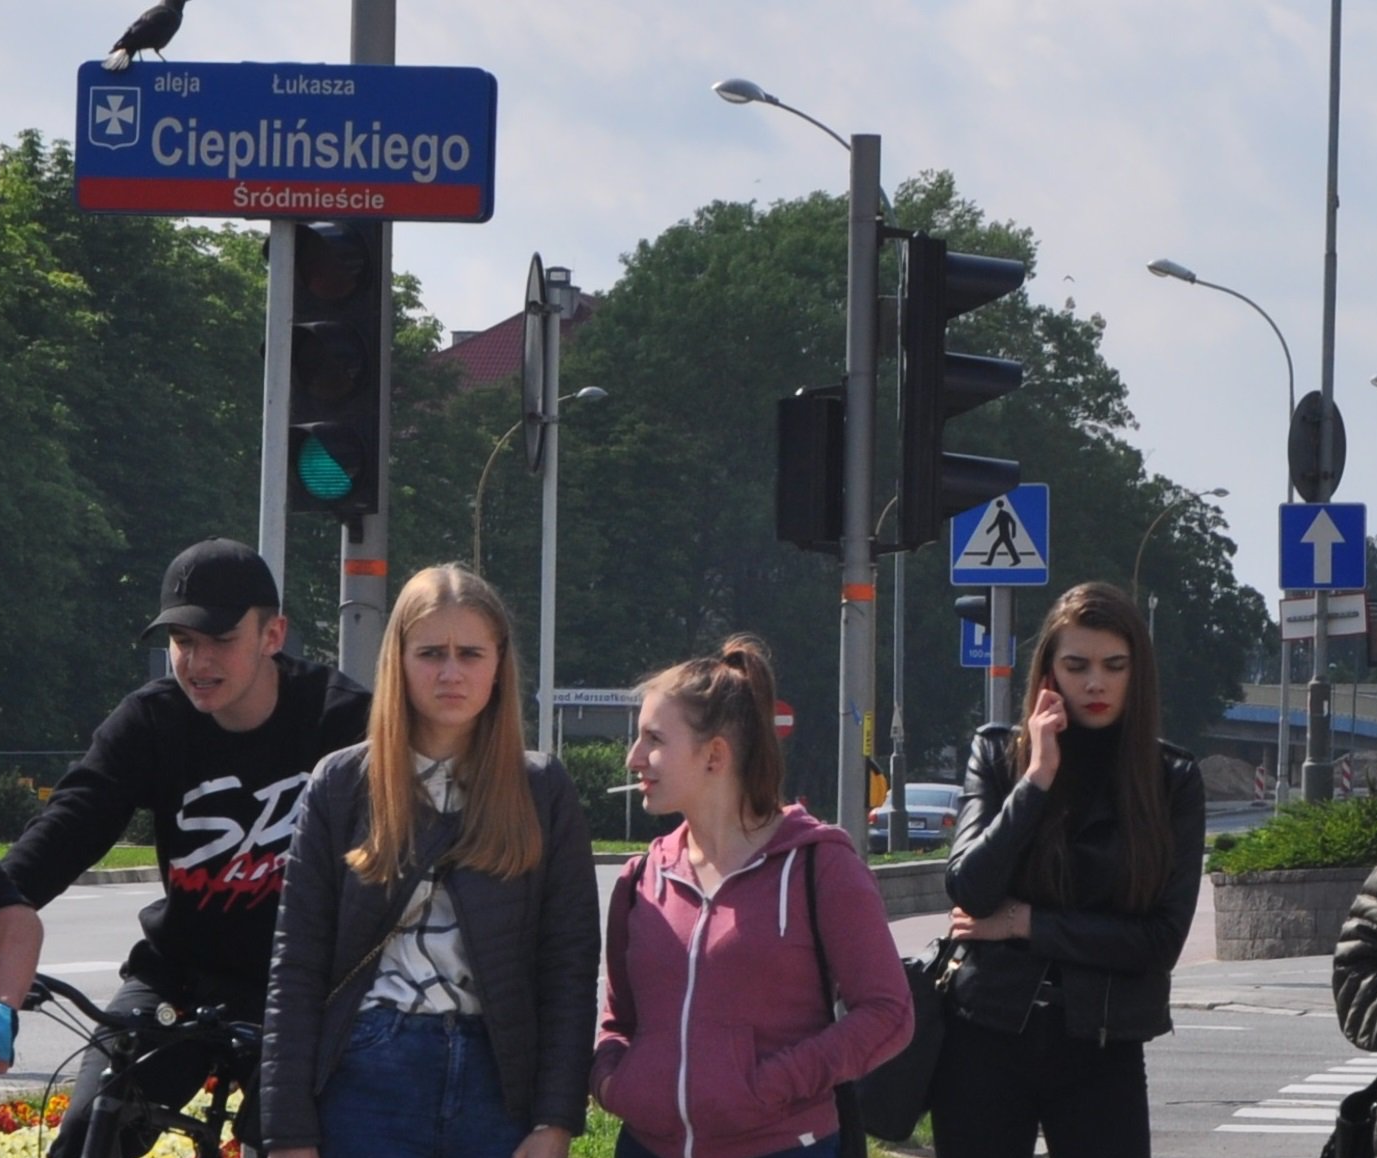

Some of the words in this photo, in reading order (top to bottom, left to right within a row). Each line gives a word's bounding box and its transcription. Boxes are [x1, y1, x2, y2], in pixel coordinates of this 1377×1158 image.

[154, 73, 201, 96] aleja
[272, 74, 355, 95] Łukasza
[152, 117, 470, 184] Cieplińskiego
[232, 184, 385, 211] Śródmieście
